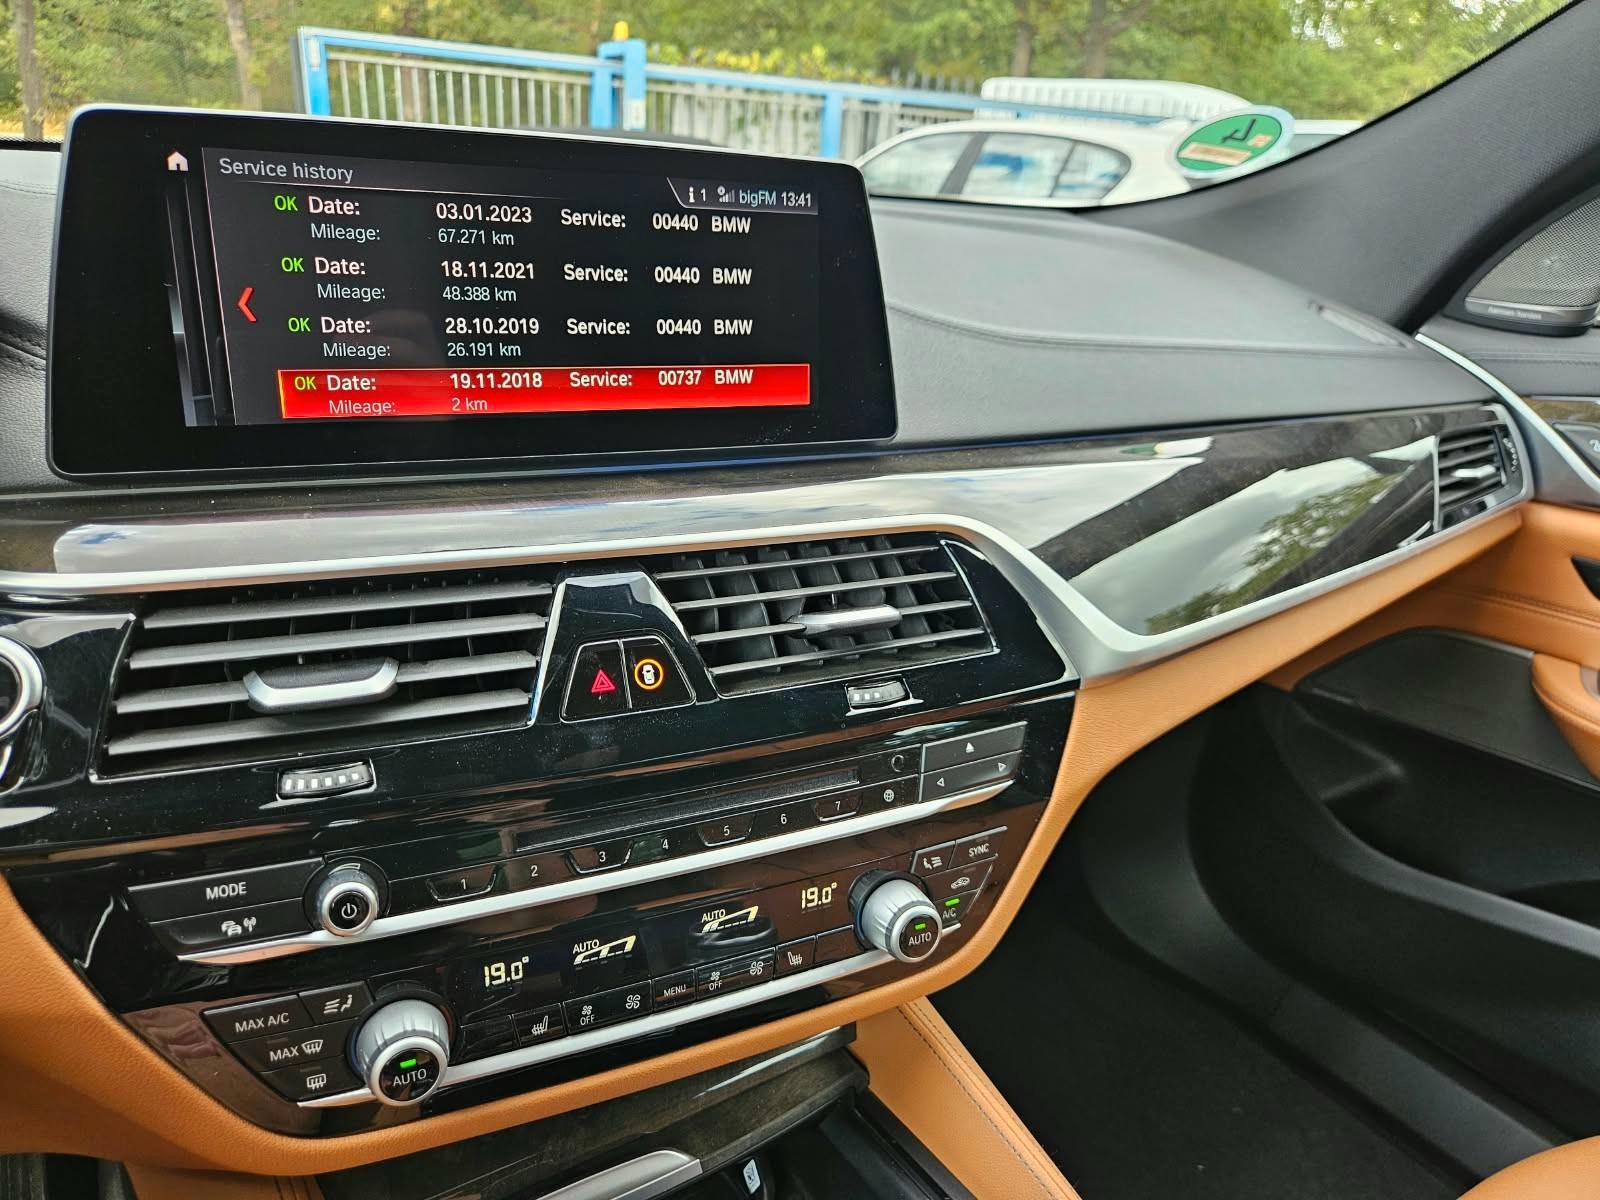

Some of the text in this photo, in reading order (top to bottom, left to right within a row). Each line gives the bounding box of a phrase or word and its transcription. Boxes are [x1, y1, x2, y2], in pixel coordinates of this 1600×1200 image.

[219, 158, 353, 184] Service history
[700, 188, 812, 208] 1 bigFM 13:41
[274, 195, 751, 234] OK Date: 03.01.2023 Service: 00440 BMW
[310, 223, 515, 246] Mileage: 67.271 km
[281, 257, 752, 285] OK Date: 18.11.2021 Service: 00440 BMW
[317, 283, 517, 302] Mileage: 48.388 km
[288, 316, 753, 337] OK Date: 28.10.2019 Service: 00440 BMW
[323, 342, 521, 360] Mileage: 26.191 km
[294, 369, 754, 391] OK Date: 19.11.2018 Service: 00737 BMW
[329, 397, 488, 415] Mileage: 2 km
[834, 800, 841, 812] 7
[780, 813, 787, 825] 6
[723, 825, 730, 837] 5
[661, 838, 669, 850] 4
[968, 843, 990, 857] SYNC
[598, 851, 606, 863] 3
[530, 865, 538, 877] 2
[206, 882, 248, 901] MODE
[461, 878, 467, 890] 1
[701, 908, 726, 923] AUTO
[942, 907, 957, 919] A/C
[572, 938, 600, 954] AUTO
[908, 931, 932, 946] AUTO
[663, 984, 687, 997] MENU
[709, 979, 723, 991] OFF
[235, 1012, 290, 1033] MAX A/C
[580, 1014, 595, 1026] OFF
[269, 1045, 299, 1062] MAX
[392, 1067, 428, 1088] AUTO
